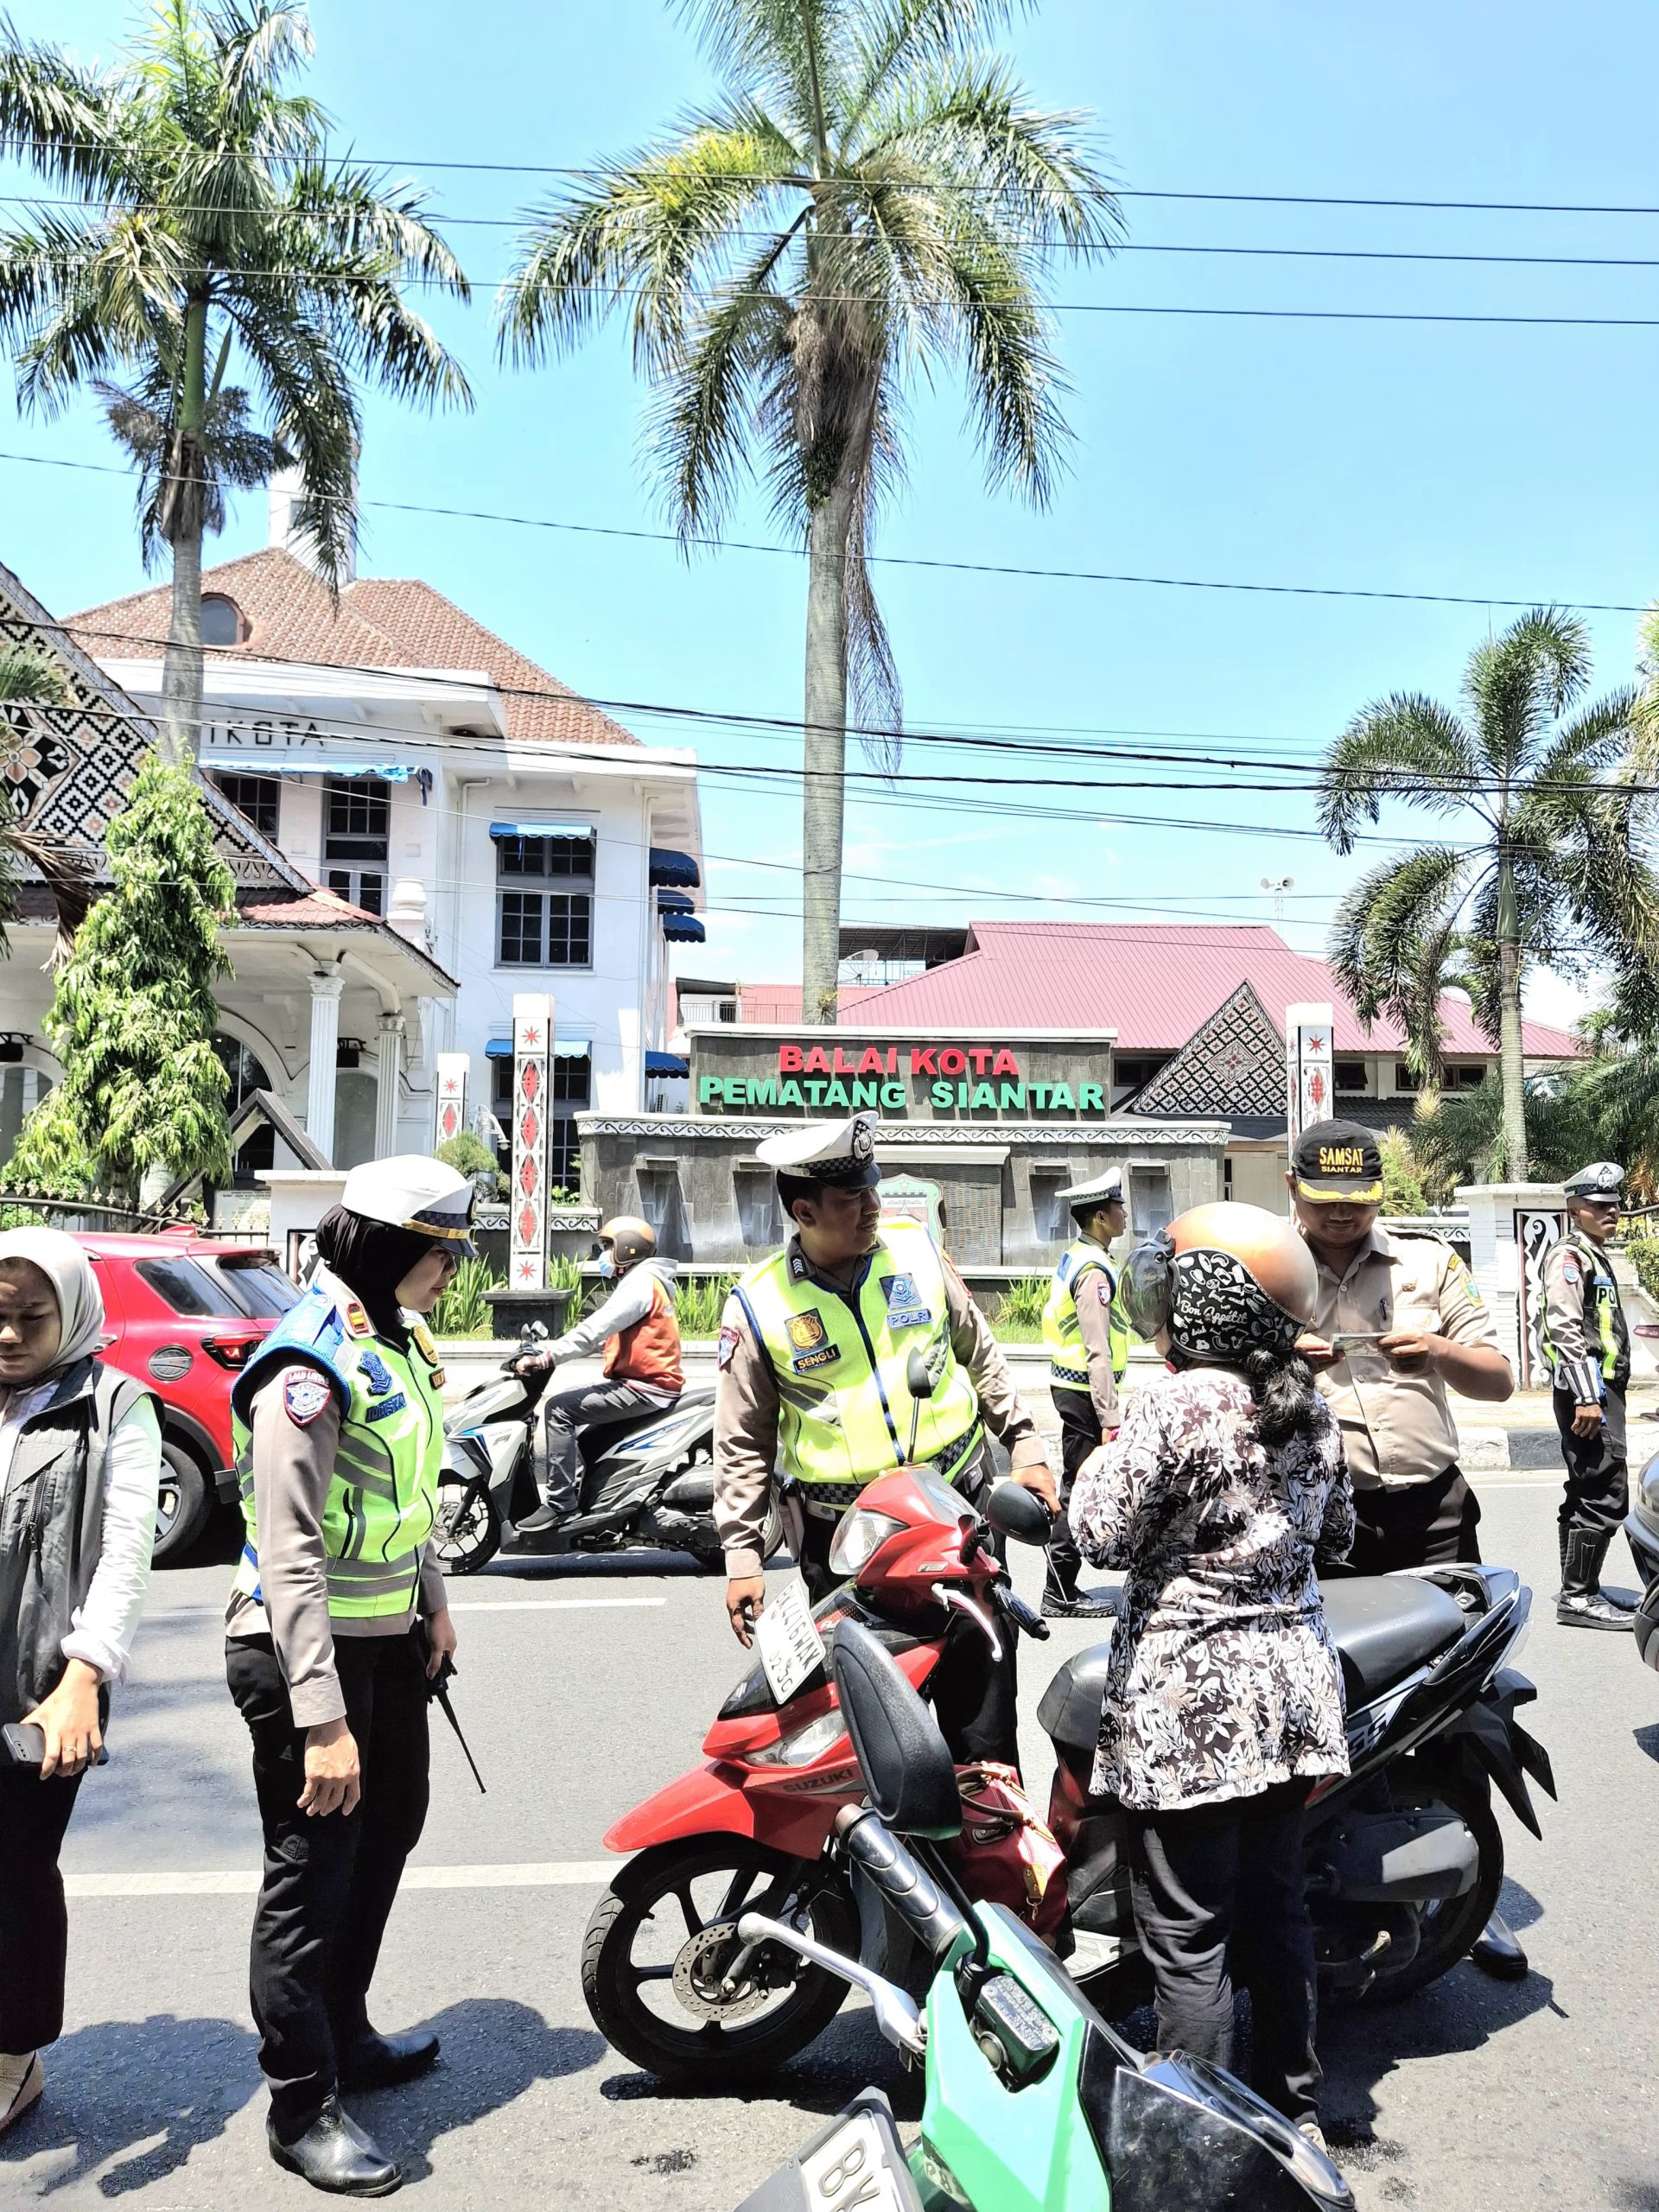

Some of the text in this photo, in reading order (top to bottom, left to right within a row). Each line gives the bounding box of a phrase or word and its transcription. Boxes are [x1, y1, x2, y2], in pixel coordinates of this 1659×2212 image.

[779, 1046, 1019, 1075] BALAI KOTA
[699, 1077, 1105, 1110] PEMATANG SIANTAR
[1319, 1147, 1363, 1166] SAMSAT
[1180, 1300, 1202, 1316] Bon
[797, 1348, 836, 1370] SENGLI
[783, 1768, 853, 1793] SUZUKI
